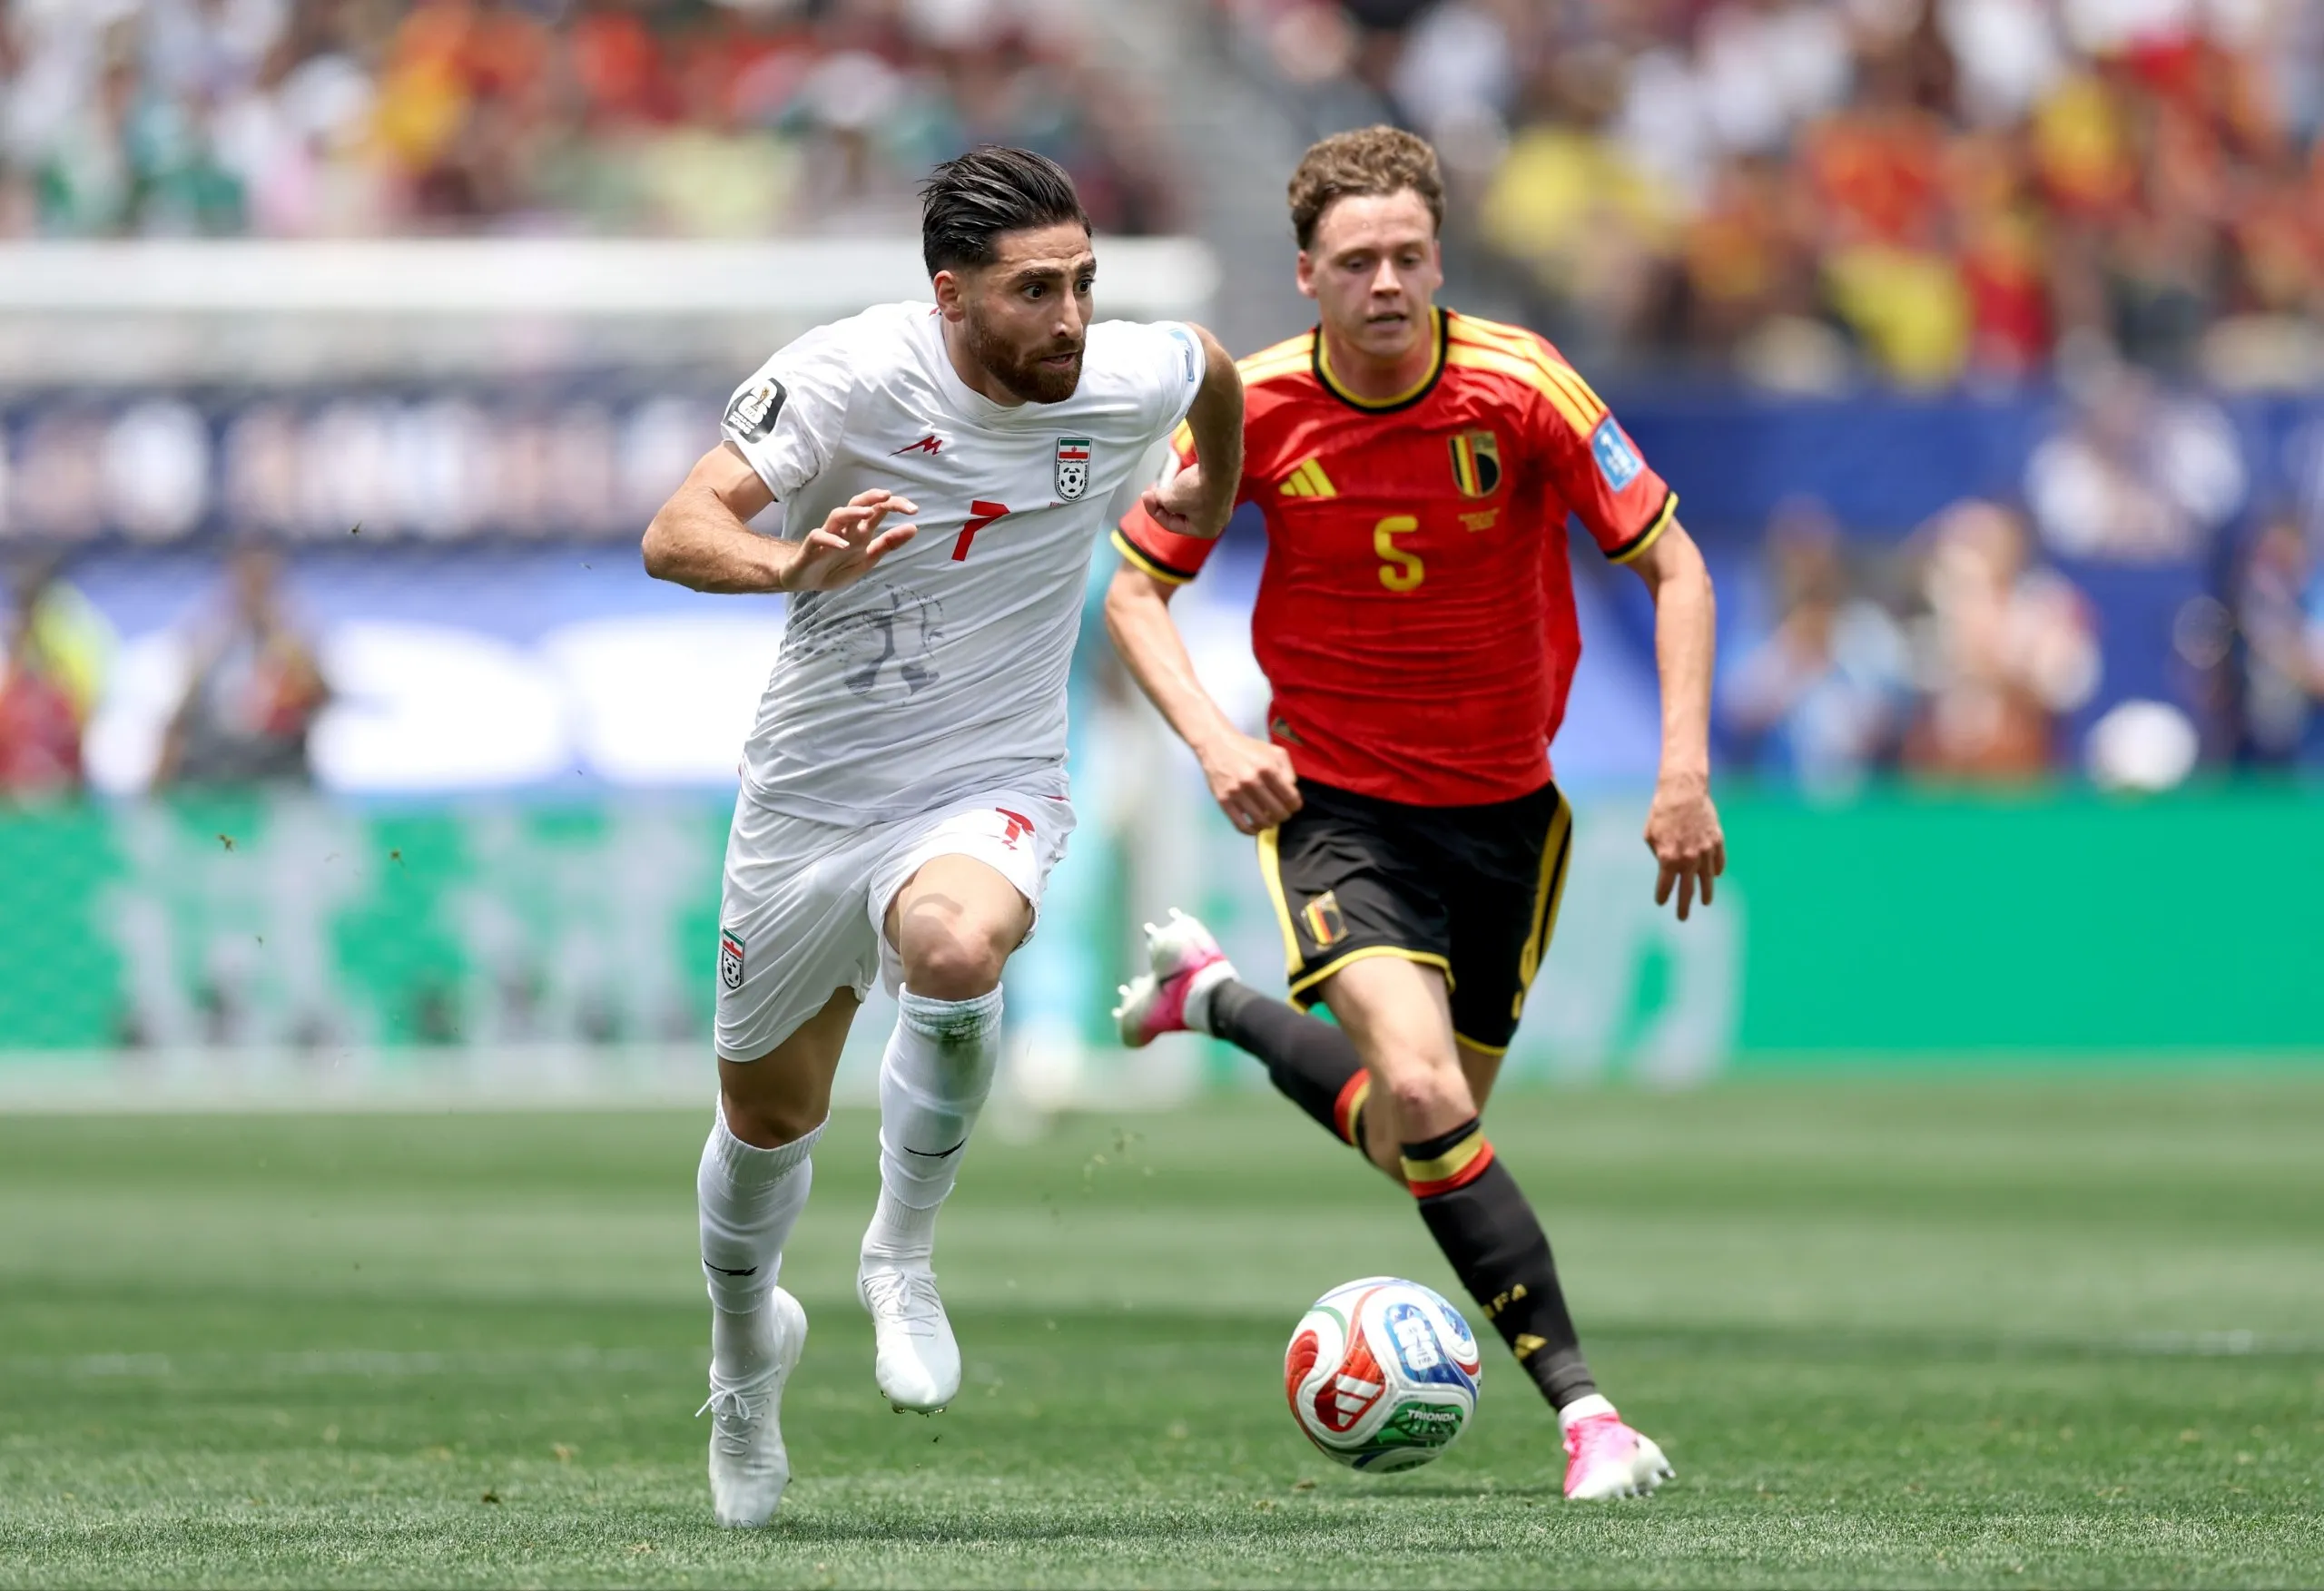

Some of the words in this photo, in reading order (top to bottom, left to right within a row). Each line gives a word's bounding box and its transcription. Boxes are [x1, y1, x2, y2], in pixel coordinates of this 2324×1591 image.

[951, 500, 1010, 561] 7
[1374, 516, 1423, 592] 5
[1407, 1409, 1456, 1422] TRIONDA
